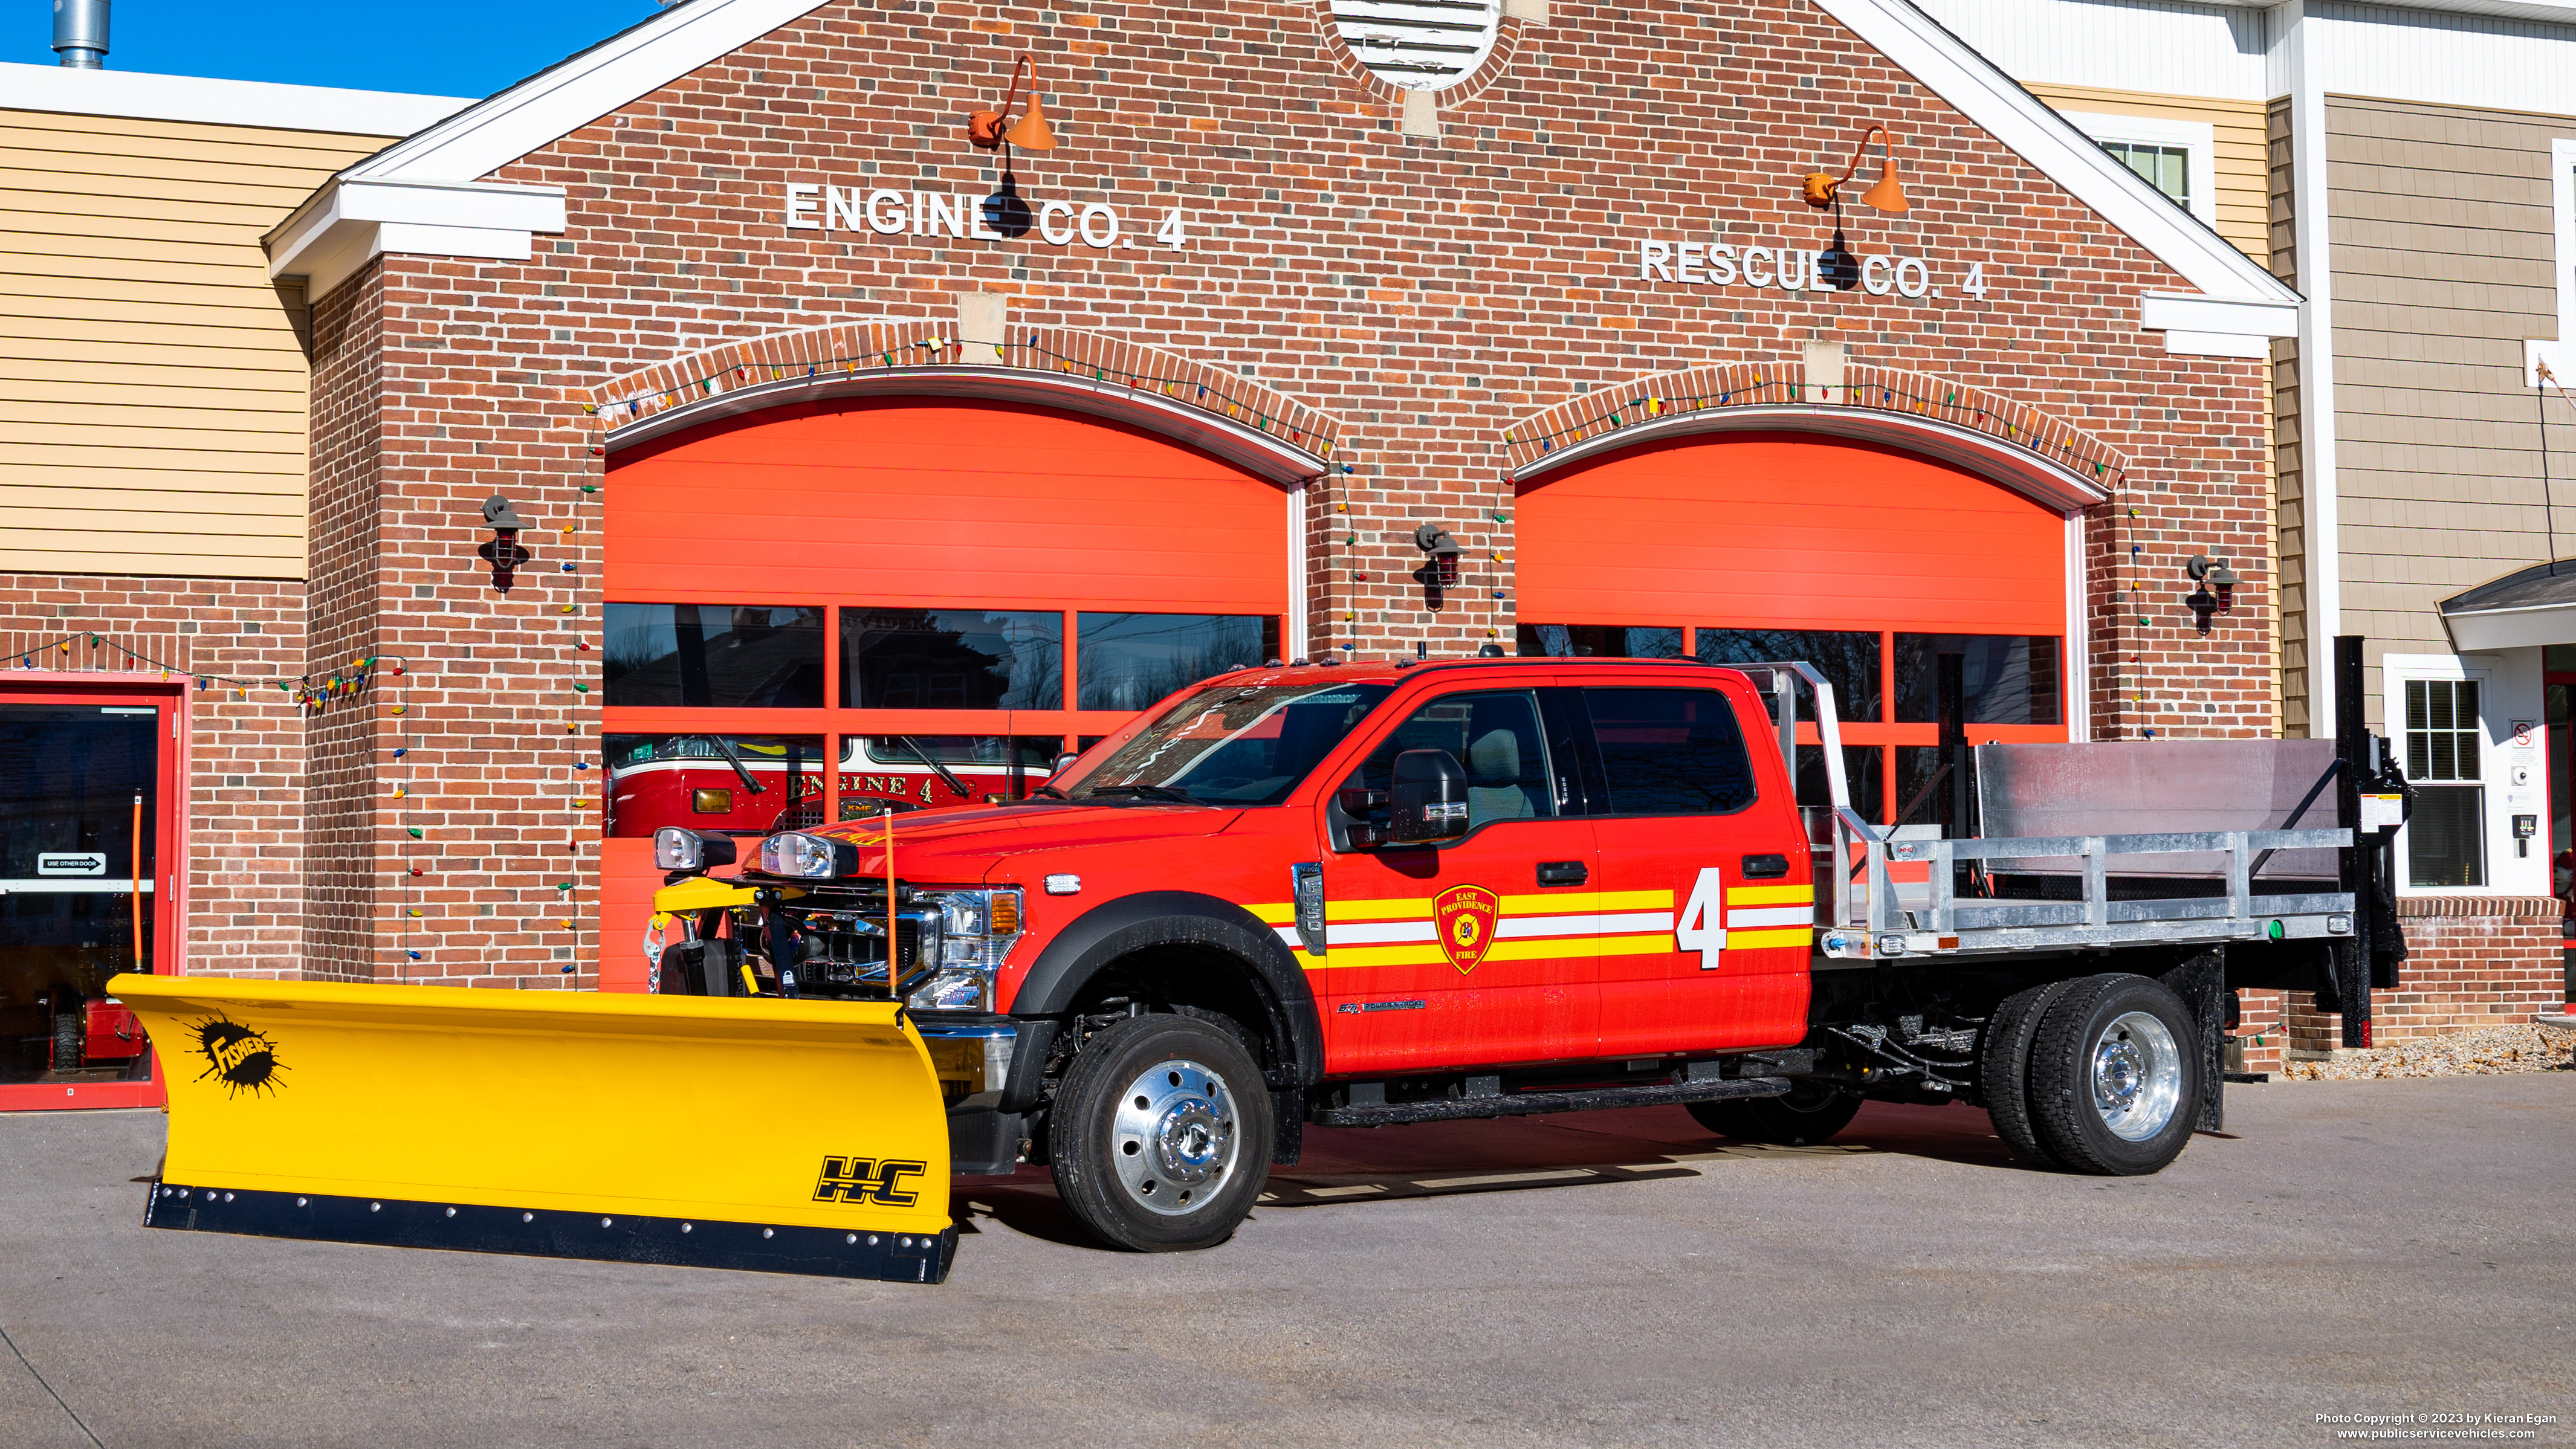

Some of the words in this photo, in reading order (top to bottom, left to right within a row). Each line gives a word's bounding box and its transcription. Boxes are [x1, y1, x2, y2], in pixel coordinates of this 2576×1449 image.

[786, 183, 1002, 240] ENGINE
[1038, 200, 1132, 249] CO.
[1157, 209, 1186, 251] 4
[1640, 240, 1837, 292] RESCUE
[1862, 254, 1940, 299] CO.
[1963, 262, 1987, 301] 4
[786, 775, 907, 800] ENGINE
[918, 778, 933, 804] 4
[1441, 900, 1493, 916] PROVIDENCE
[1455, 892, 1477, 902] EAST
[1675, 867, 1727, 970] 4
[1455, 950, 1477, 960] FIRE
[210, 1036, 270, 1076] FISHER
[812, 1155, 927, 1207] HC
